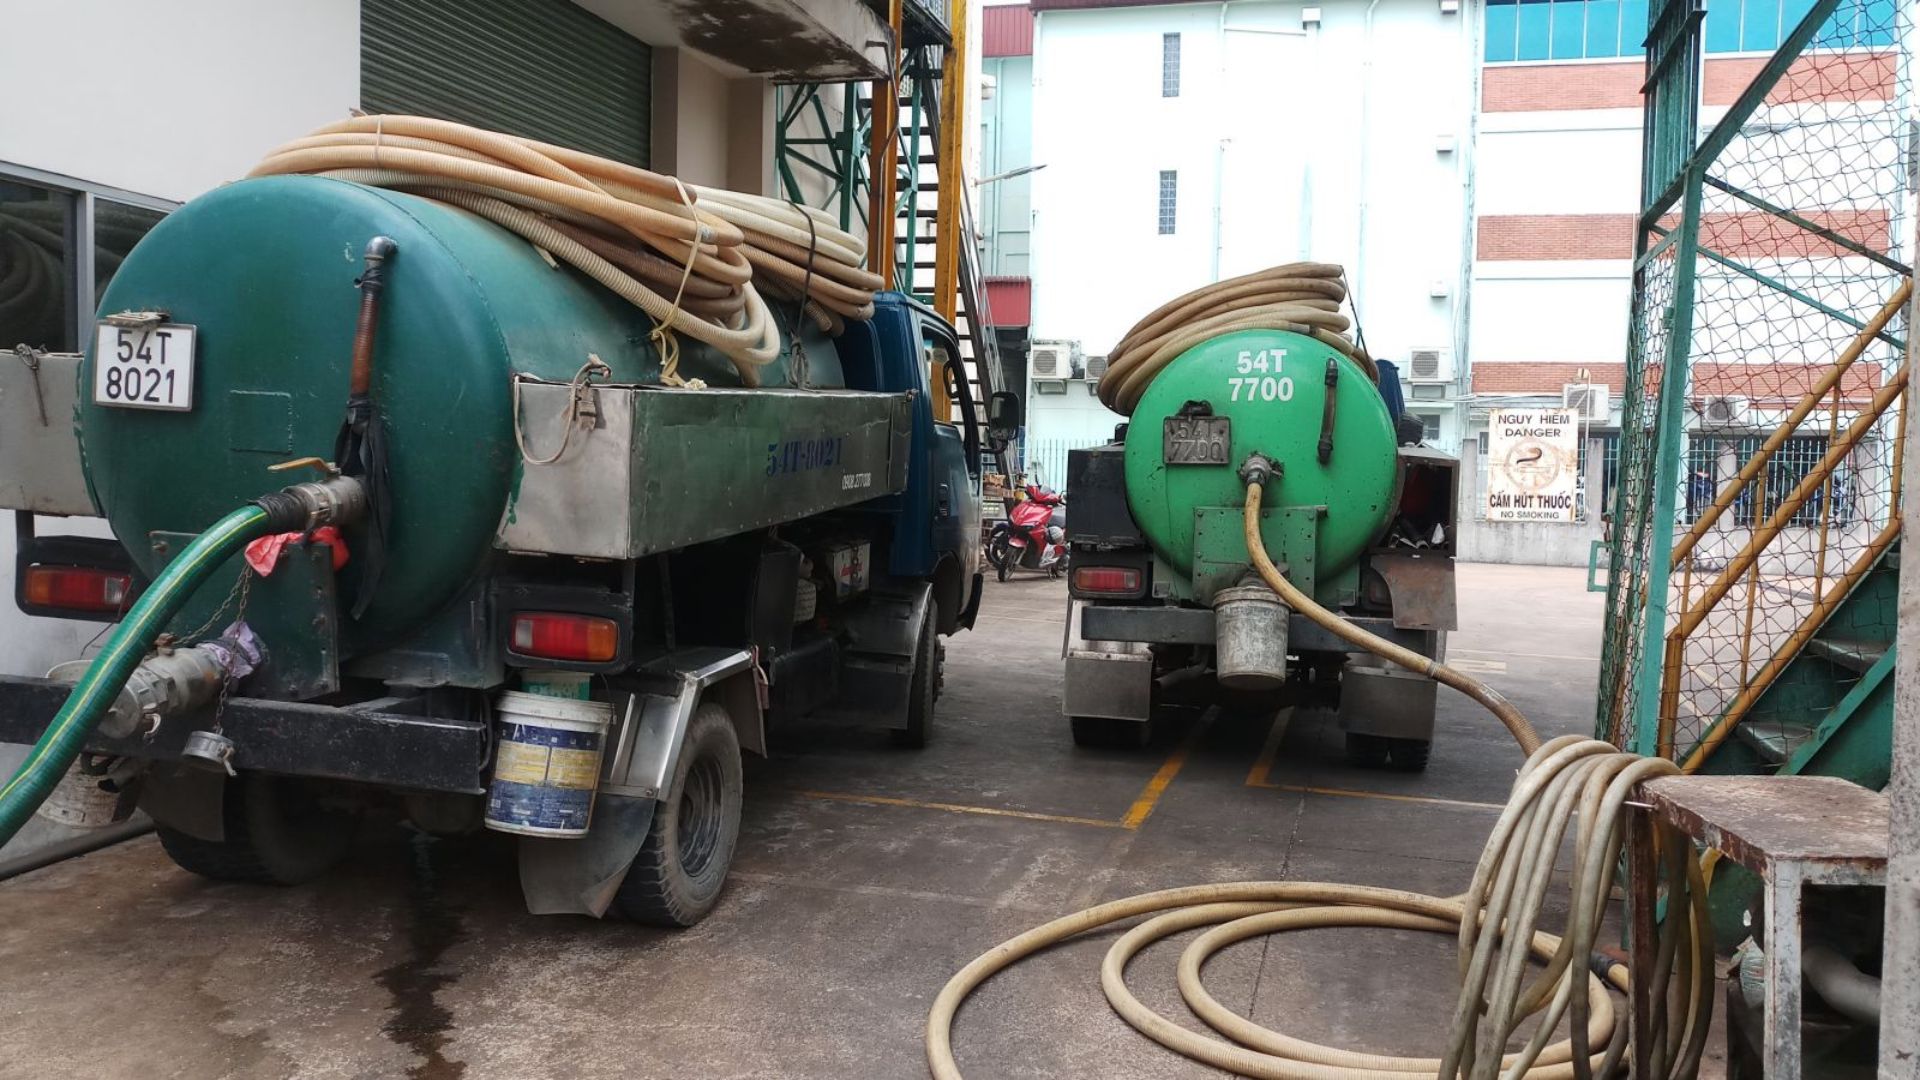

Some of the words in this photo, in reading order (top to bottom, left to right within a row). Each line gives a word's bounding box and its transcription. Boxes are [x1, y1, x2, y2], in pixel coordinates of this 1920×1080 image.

[117, 329, 172, 365] 54T
[1236, 349, 1288, 374] 54T
[106, 366, 175, 404] 8021
[1228, 377, 1294, 402] 7700
[1177, 421, 1214, 439] 54T
[1498, 414, 1533, 425] NGUY
[1505, 428, 1562, 438] DANGER
[1169, 439, 1224, 462] 7700
[1501, 510, 1514, 519] NO
[1517, 510, 1560, 519] SMOKING
